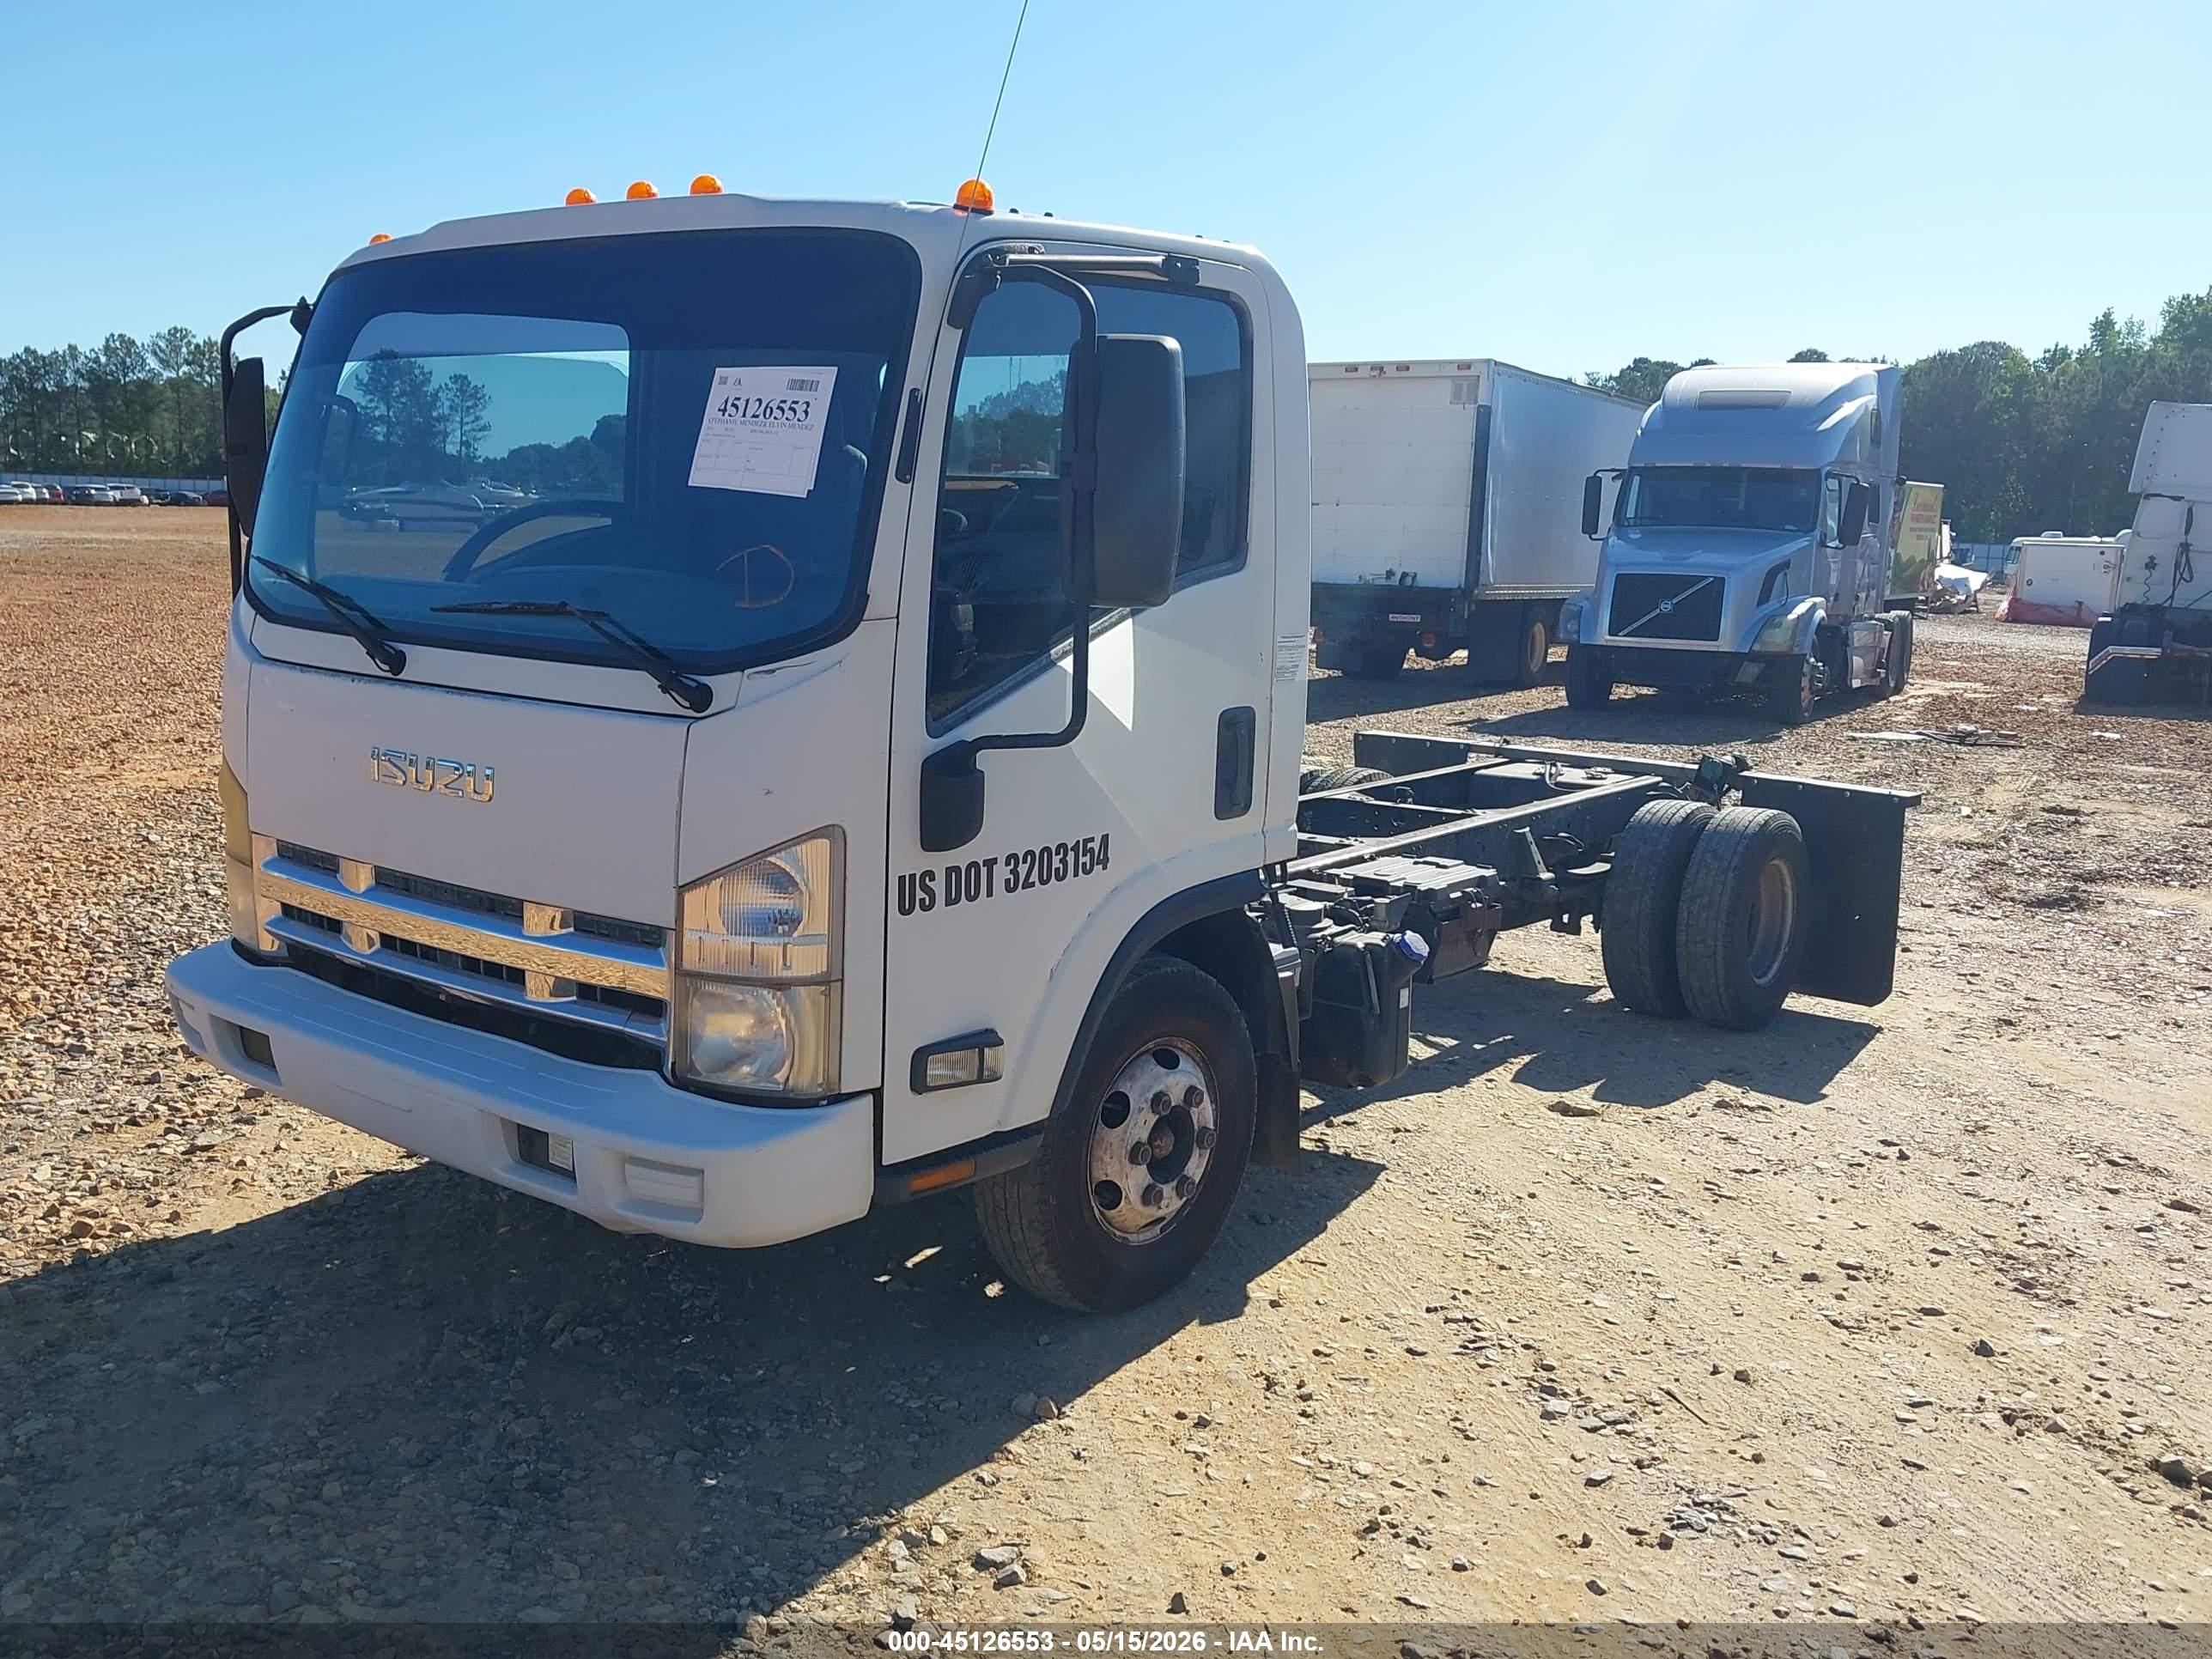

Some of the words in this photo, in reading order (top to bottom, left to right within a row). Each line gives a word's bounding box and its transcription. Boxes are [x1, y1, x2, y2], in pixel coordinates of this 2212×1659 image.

[717, 395, 811, 422] 45126553
[787, 422, 815, 431] MENDEZ
[370, 746, 495, 803] ISUZU
[897, 869, 937, 916] US
[944, 856, 999, 908] DOT
[1004, 833, 1110, 894] 3203154
